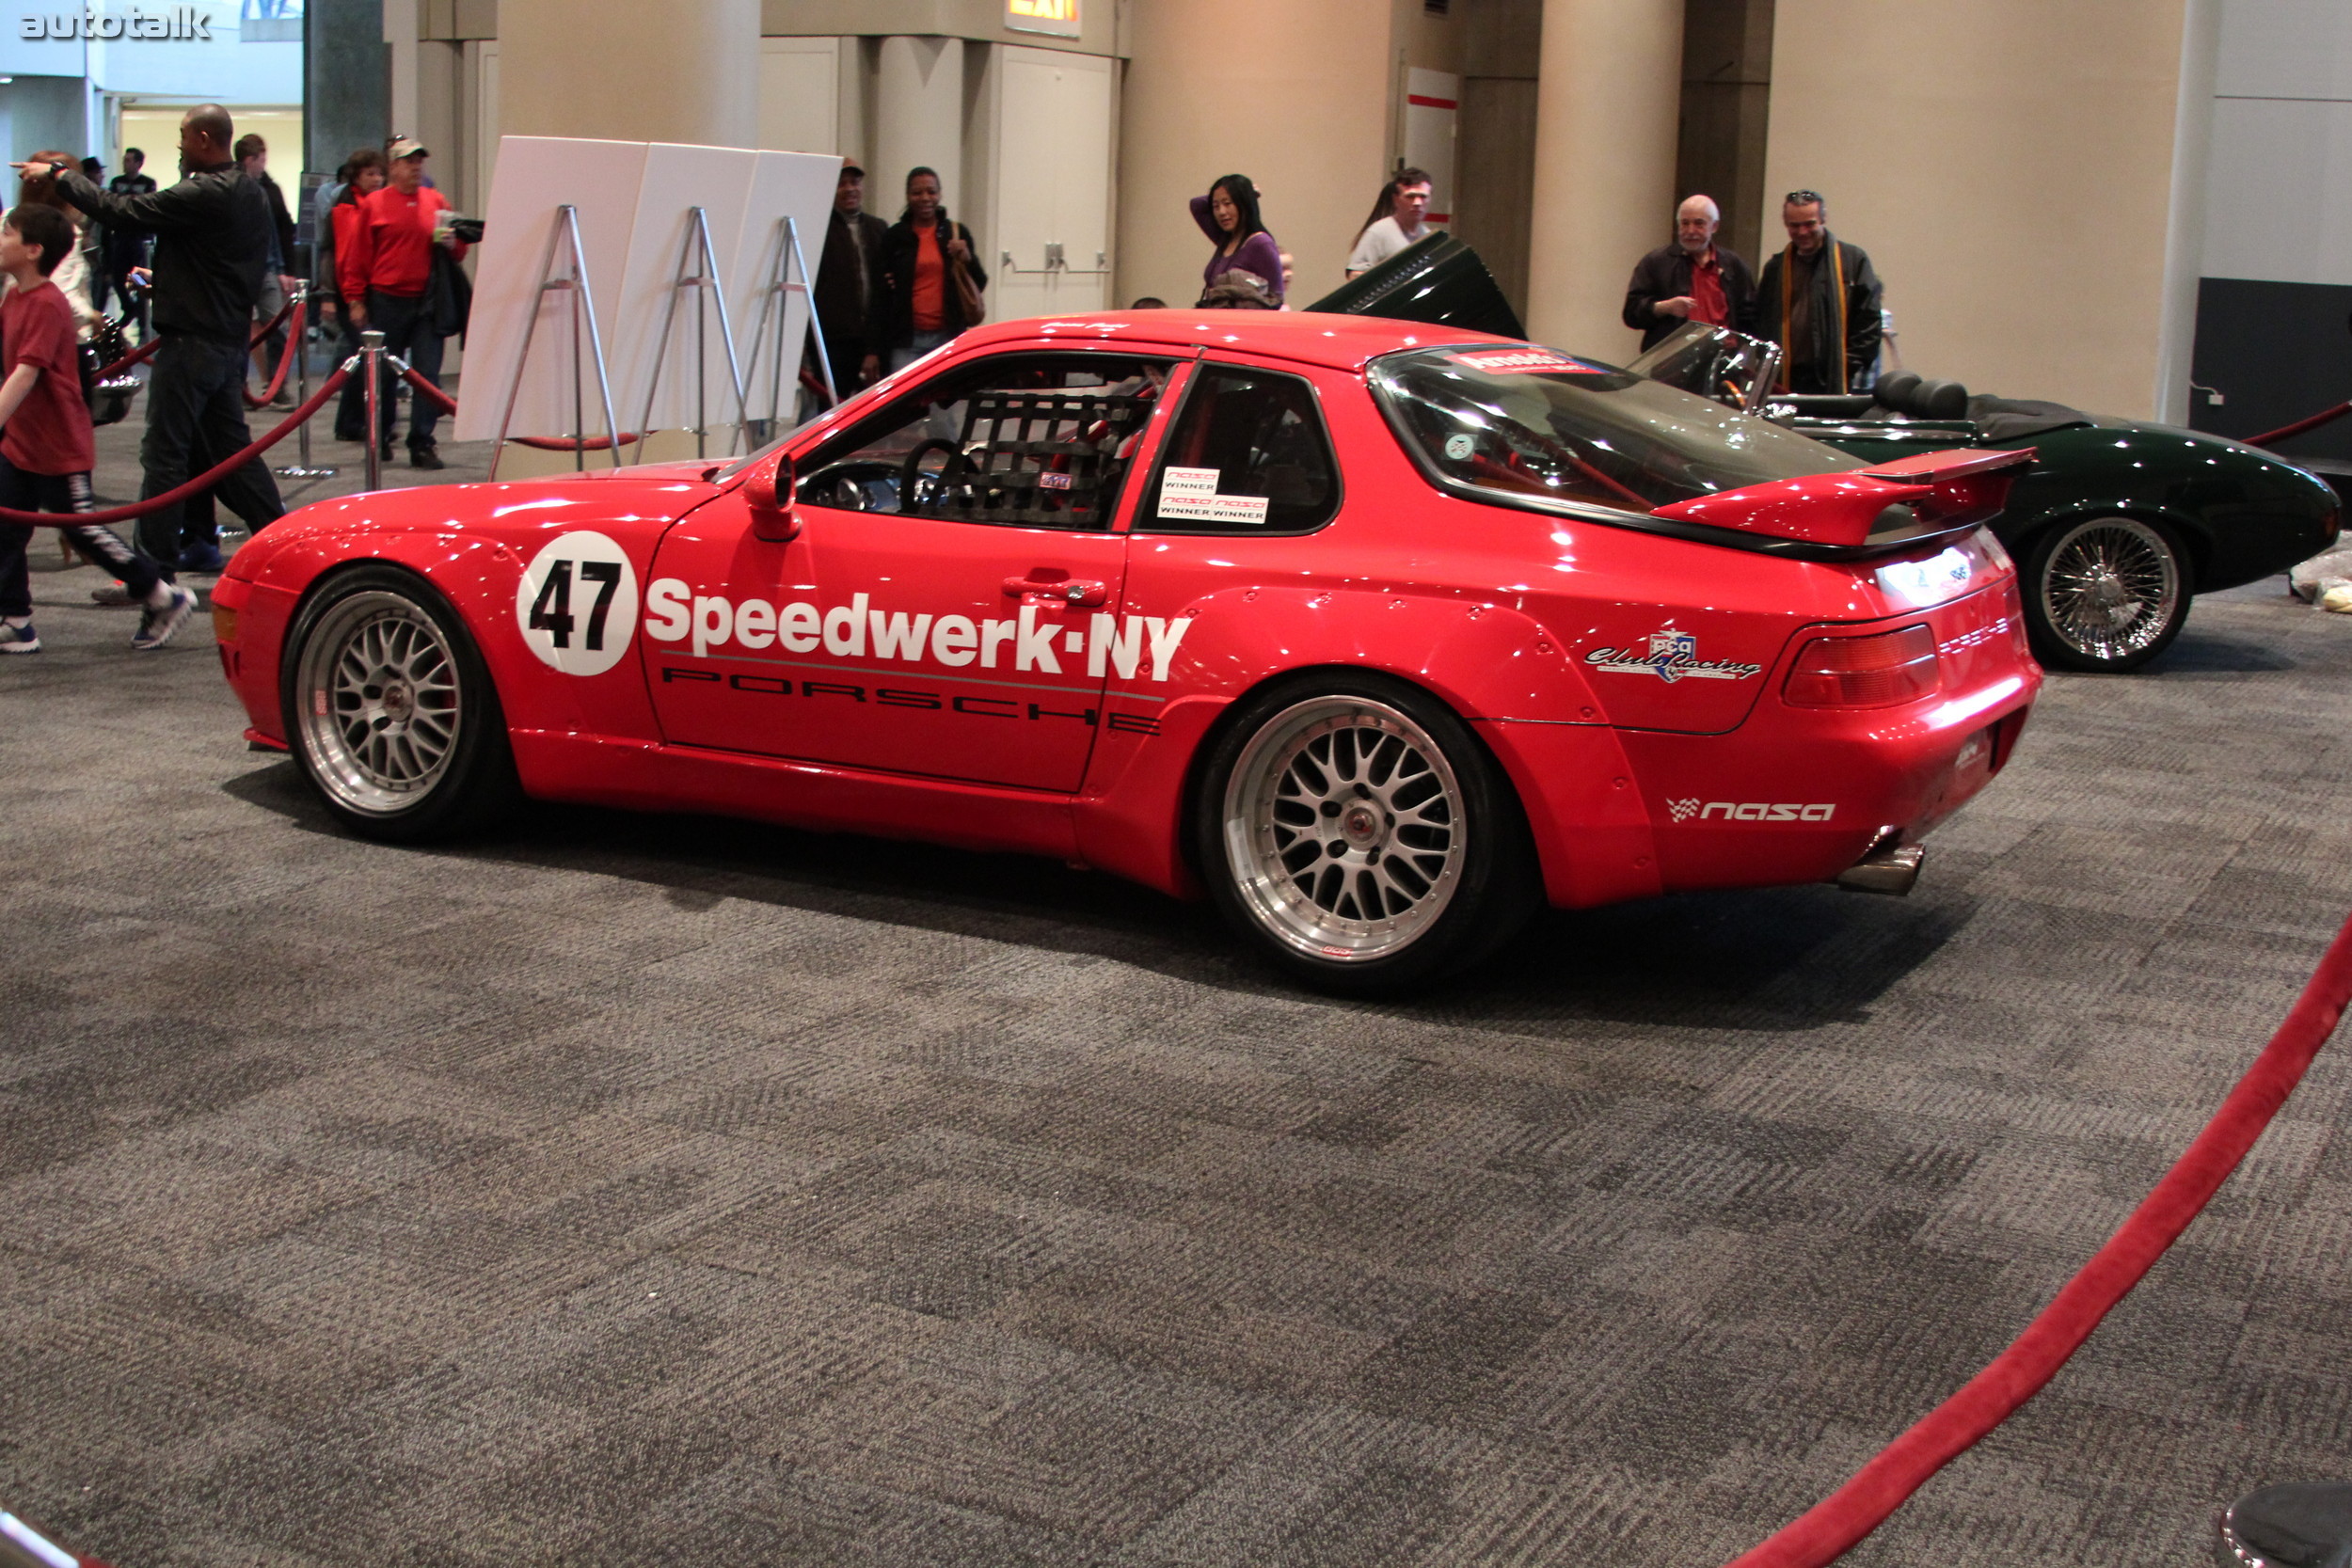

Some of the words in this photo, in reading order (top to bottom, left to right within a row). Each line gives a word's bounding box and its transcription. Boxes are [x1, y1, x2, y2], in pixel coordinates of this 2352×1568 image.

[1165, 482, 1215, 491] WINNER
[1160, 507, 1210, 515] WINNER
[1214, 510, 1264, 519] WINNER
[529, 559, 622, 650] 47
[1584, 647, 1664, 669] Club
[1661, 651, 1761, 680] Racing
[662, 667, 1161, 736] PORSCHE
[1699, 801, 1836, 821] nasa
